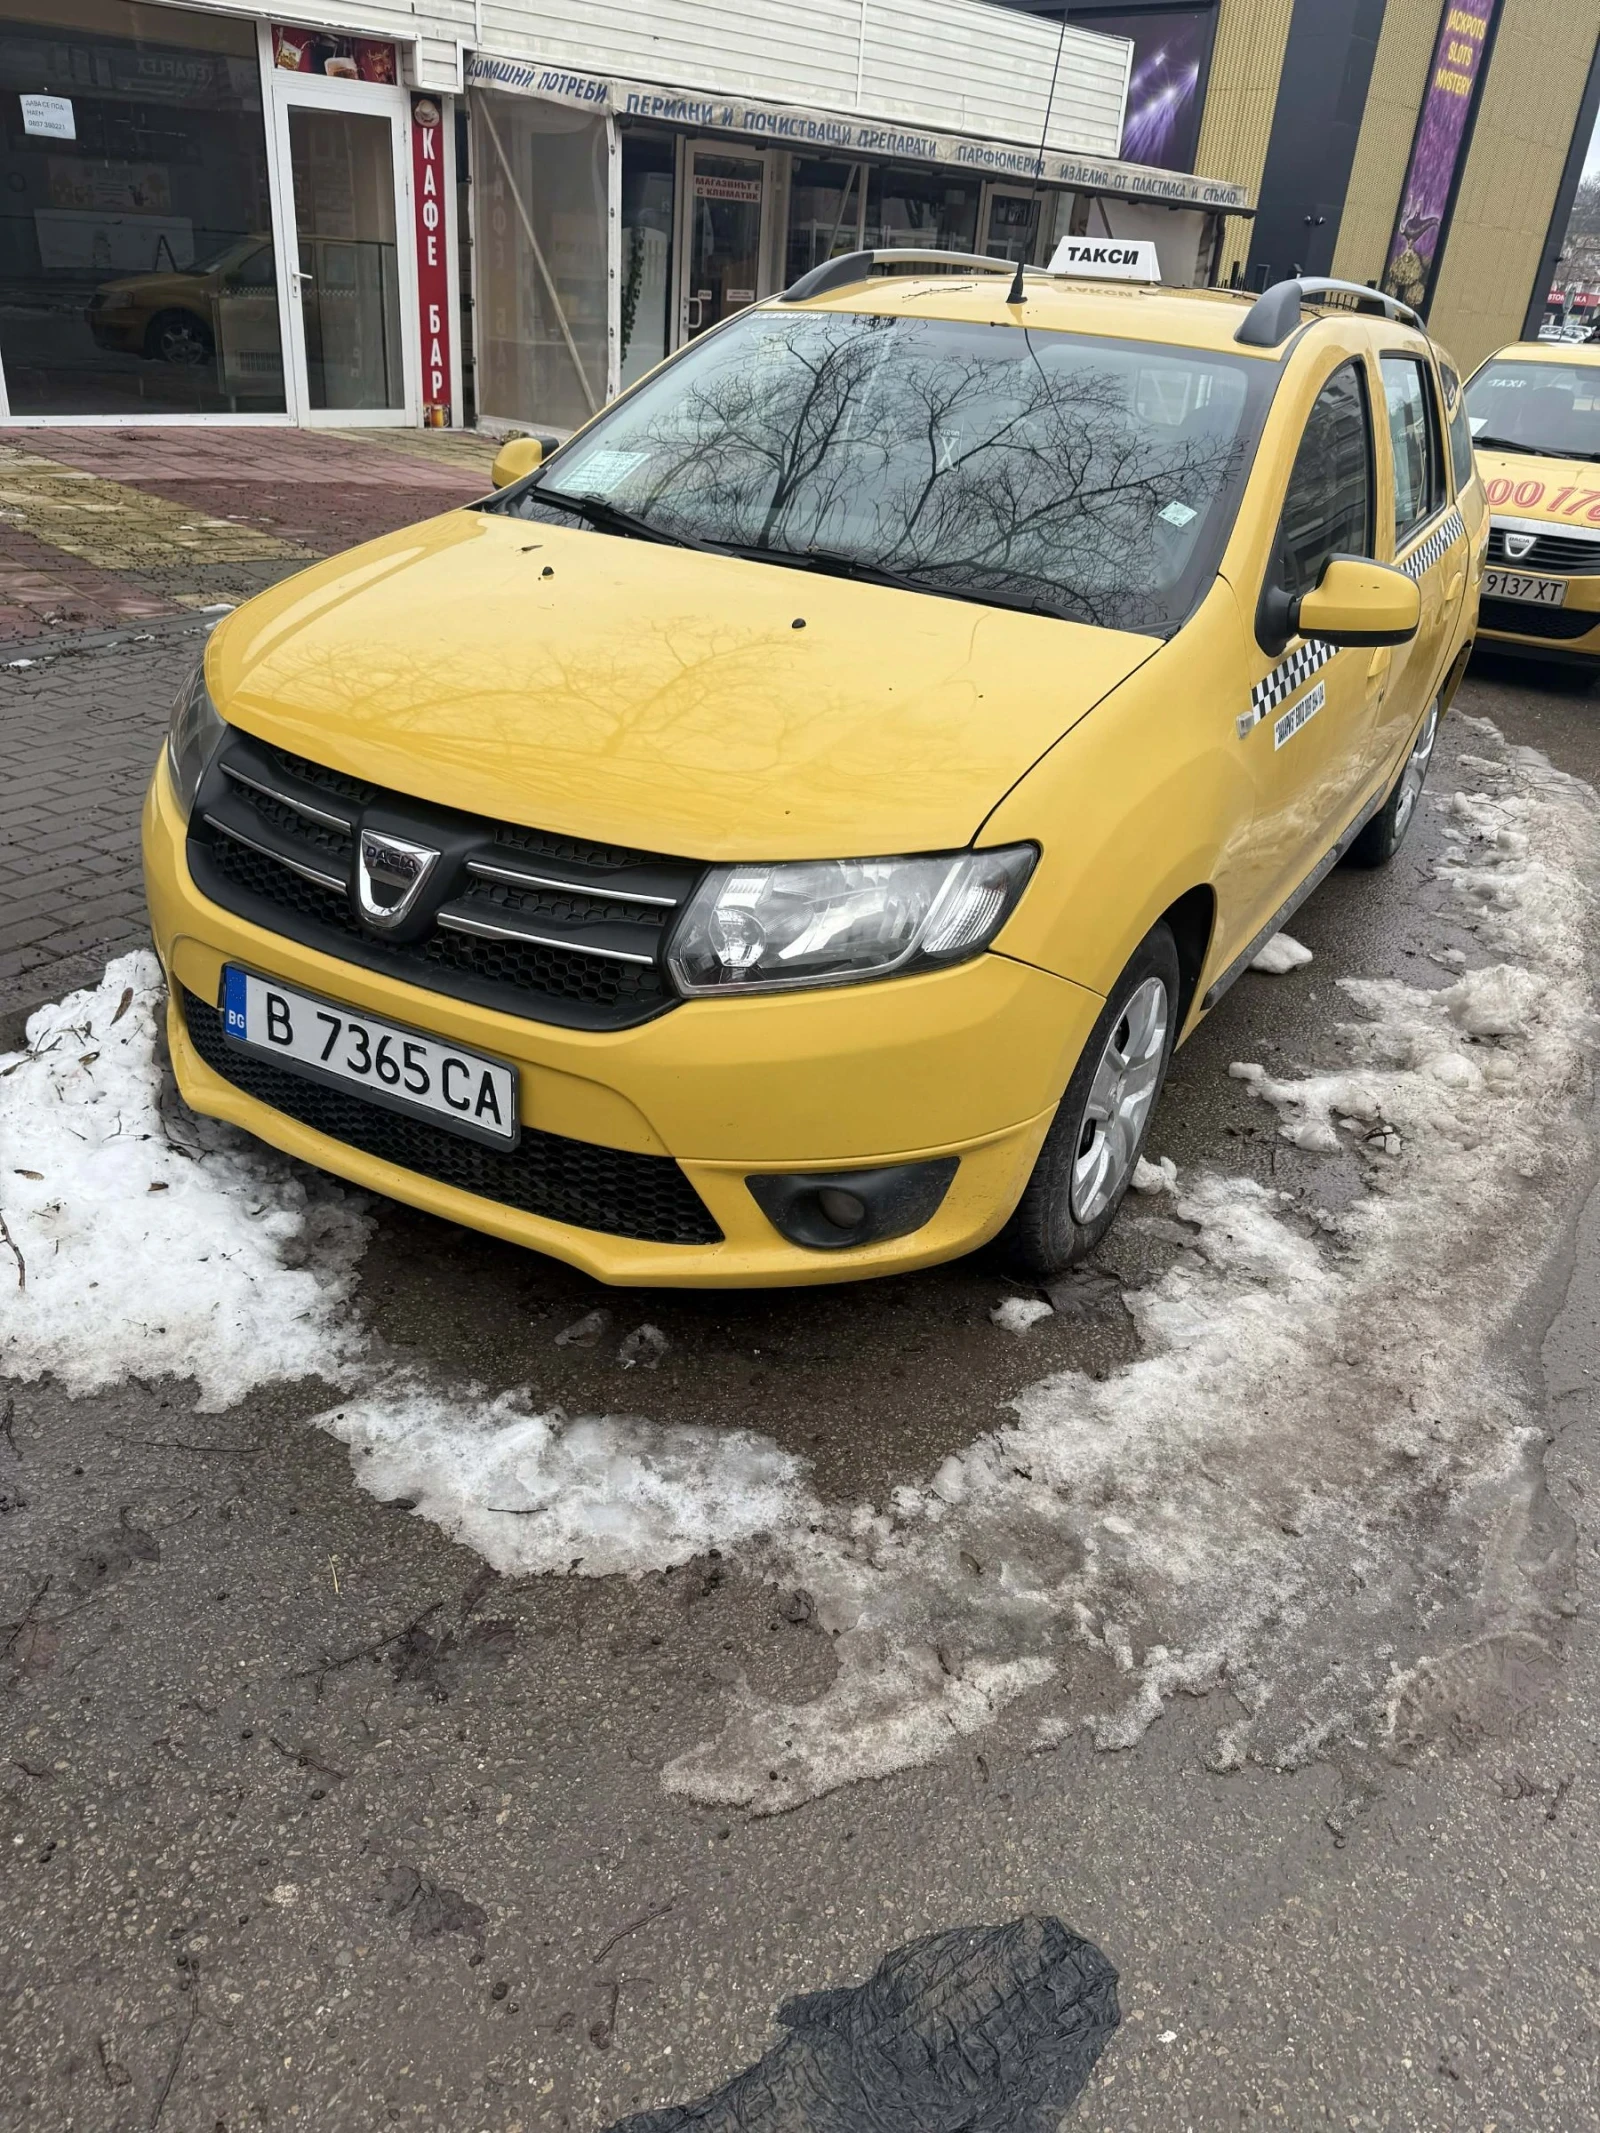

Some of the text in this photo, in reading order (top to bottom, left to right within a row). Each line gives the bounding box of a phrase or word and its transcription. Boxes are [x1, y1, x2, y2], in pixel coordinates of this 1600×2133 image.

[1446, 8, 1487, 40] JACKPOTS
[1448, 41, 1473, 67] SLOTS
[466, 59, 608, 104] ДОМАШНИ ПОТРЕБИ
[1435, 67, 1472, 96] MYSTERY
[626, 93, 937, 158] ПЕРИЛНИ И ПОЧИСТВАЩИ ПРЕПАРАТИ
[957, 145, 1046, 176] ПАРФЮМЕРИЯ
[695, 177, 760, 191] МАГАЗИНЪТ Е
[697, 187, 759, 200] С КЛИМАТИК
[1059, 164, 1108, 186] ИЗДЕЛИЯ
[1113, 174, 1128, 189] ОТ
[1132, 178, 1186, 198] ПЛАСТМАСА
[1191, 186, 1198, 197] И
[422, 127, 443, 399] КАФЕ БАР
[1067, 246, 1139, 265] ТАКСИ
[1490, 379, 1526, 388] TAXI
[1486, 573, 1562, 602] 9137 XT
[366, 845, 418, 873] DACIA
[228, 1009, 245, 1029] BG
[266, 992, 503, 1126] B 7365 CA
